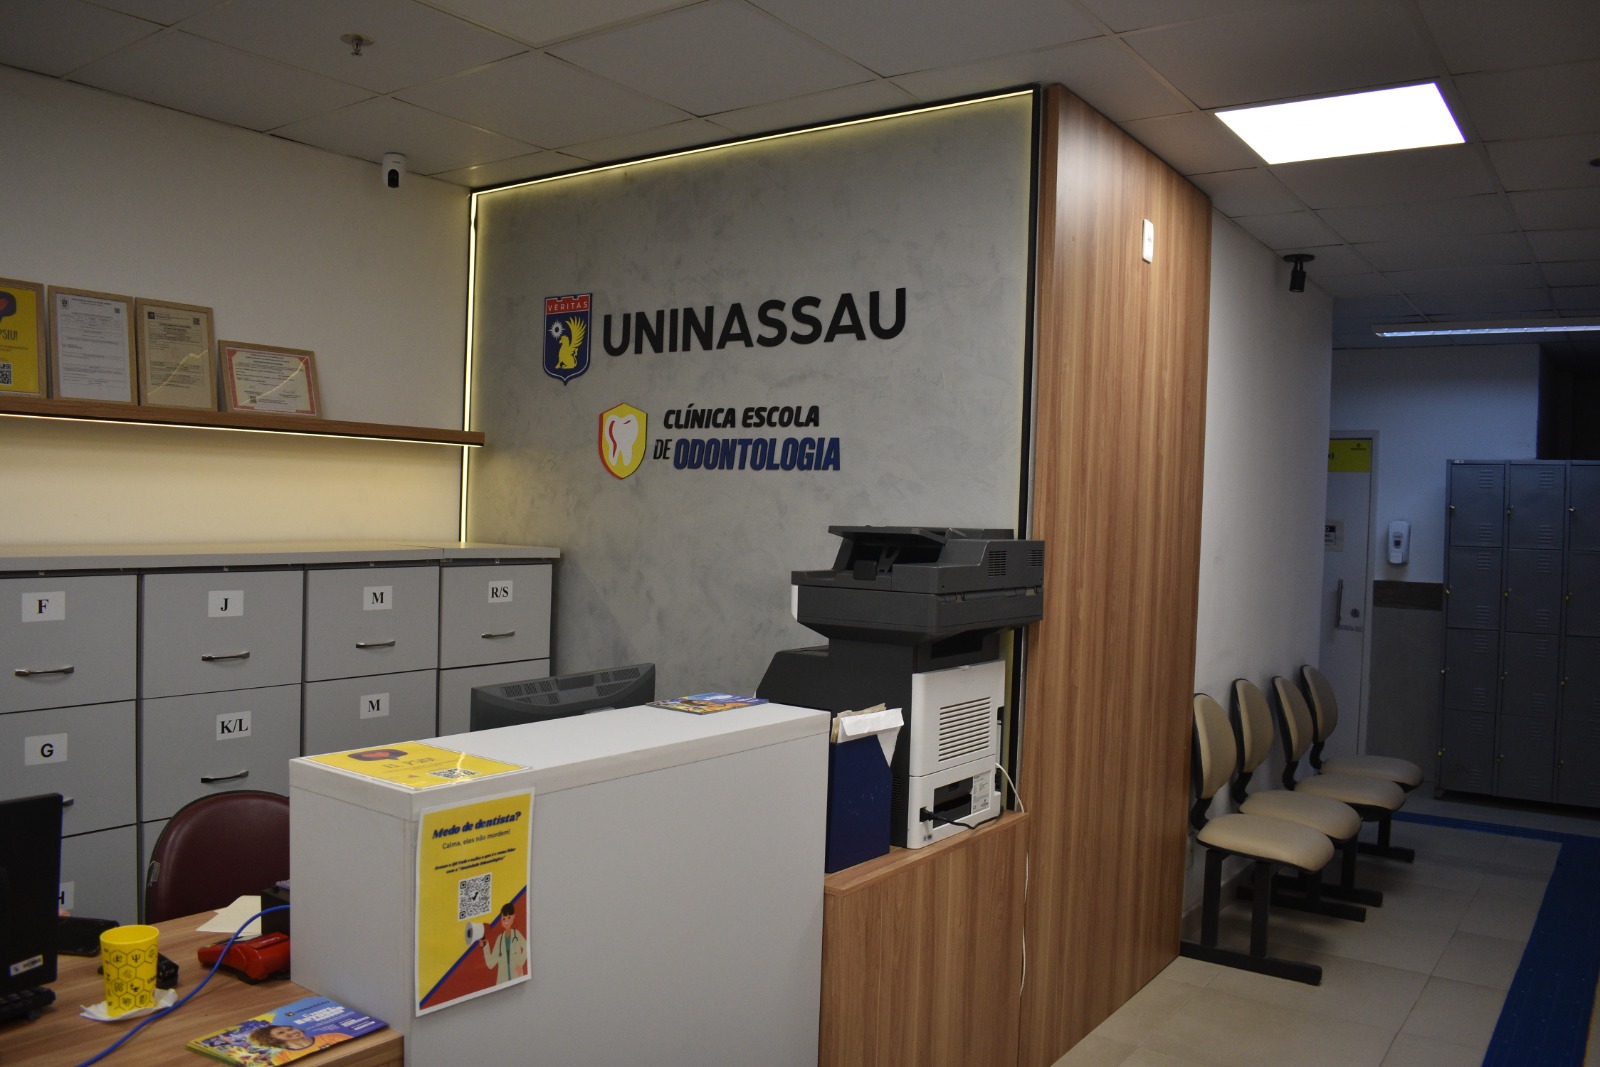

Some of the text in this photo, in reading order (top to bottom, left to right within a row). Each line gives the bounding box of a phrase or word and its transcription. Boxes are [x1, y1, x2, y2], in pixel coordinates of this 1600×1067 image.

[547, 301, 588, 312] VERITAS
[603, 288, 906, 357] UNINASSAU
[664, 403, 820, 430] CLÍNICA ESCOLA
[653, 438, 841, 471] DE ODONTOLOGIA
[371, 591, 385, 605] M
[491, 581, 510, 599] R/S
[37, 599, 50, 615] F
[220, 598, 231, 612] J
[368, 699, 381, 713] M
[220, 717, 249, 736] K/L
[40, 743, 54, 759] G
[432, 811, 521, 839] Medo de dentista?
[463, 837, 475, 845] eles
[475, 834, 486, 842] não
